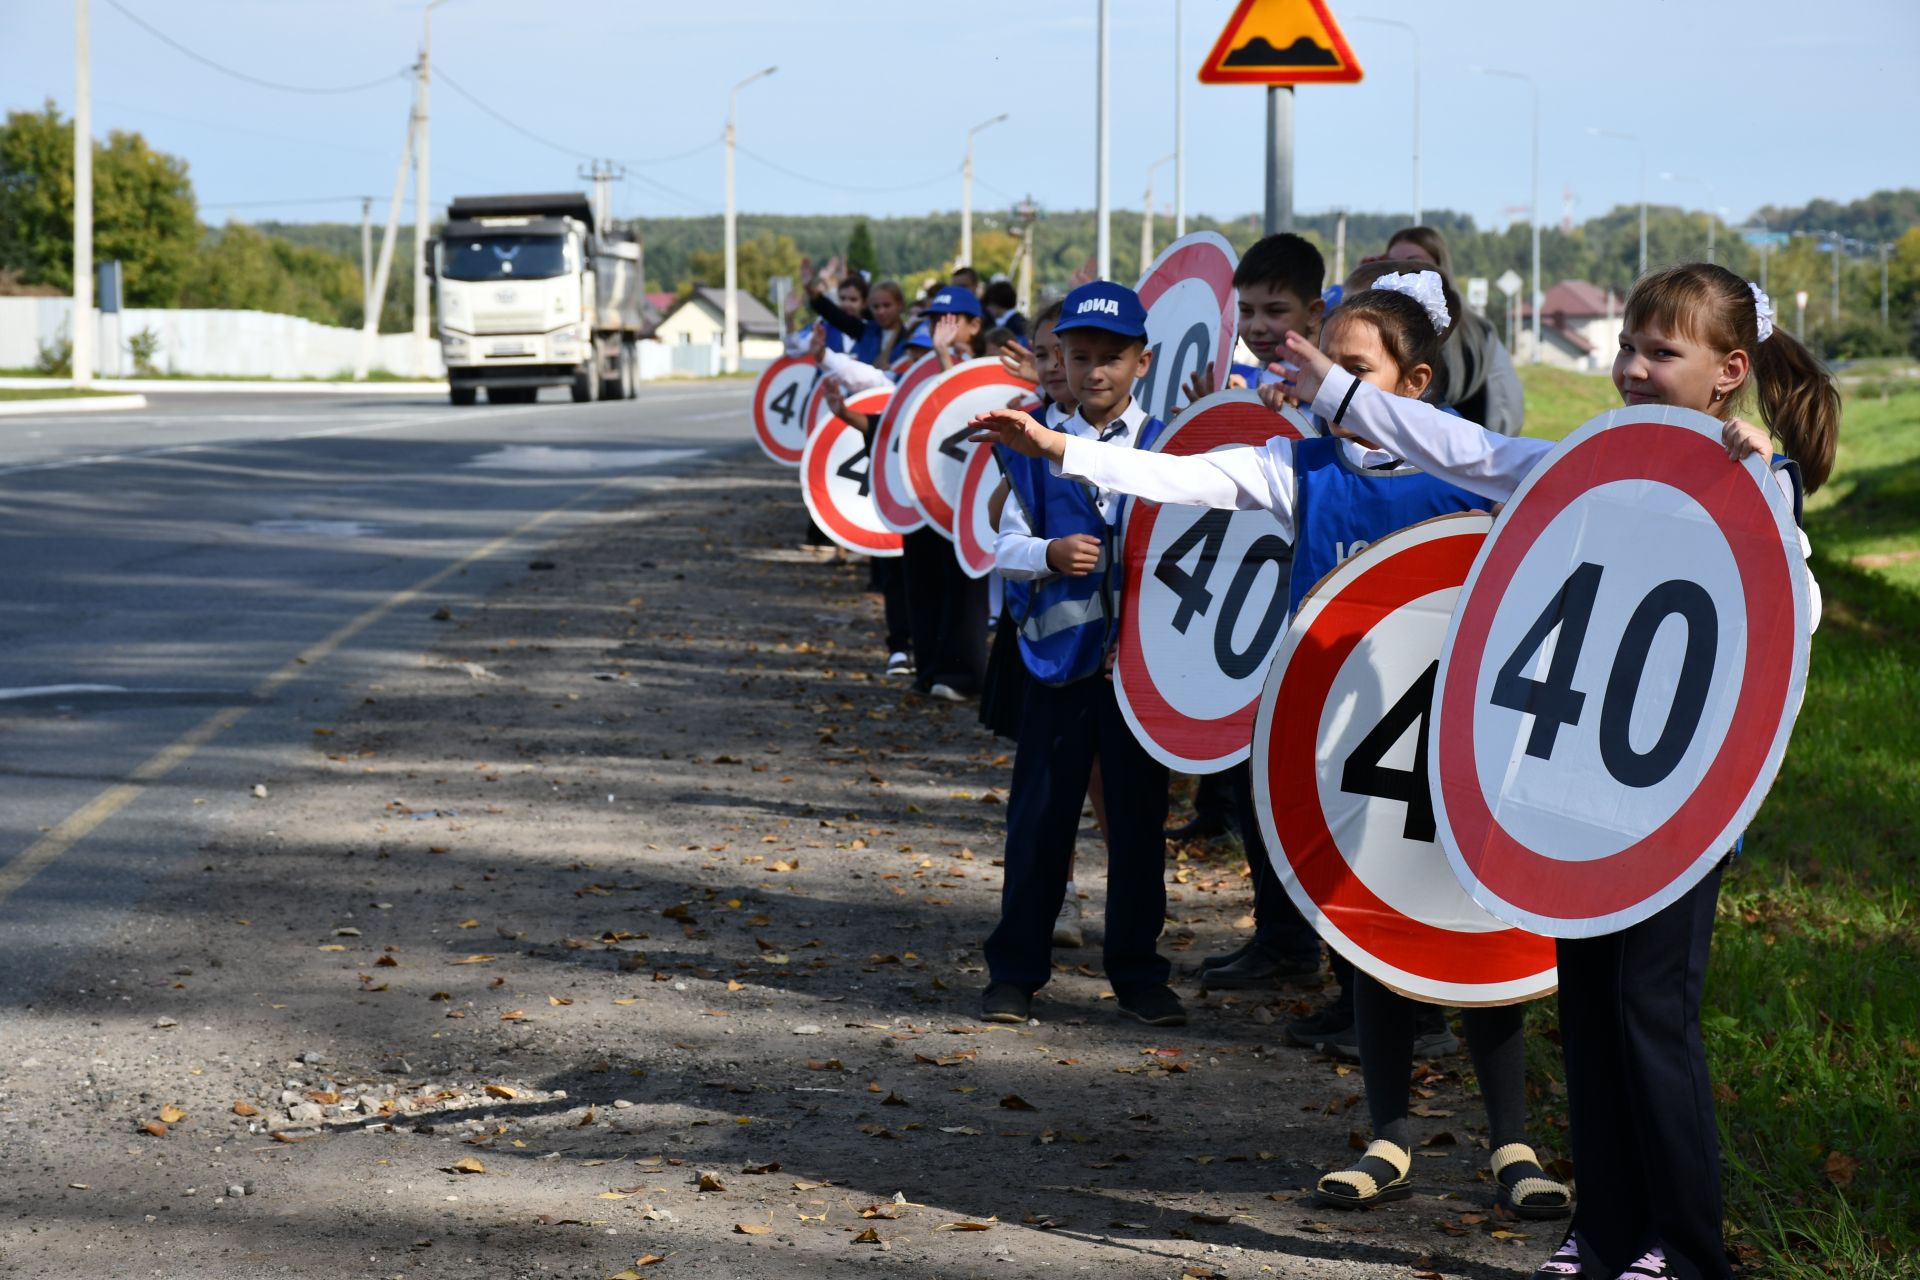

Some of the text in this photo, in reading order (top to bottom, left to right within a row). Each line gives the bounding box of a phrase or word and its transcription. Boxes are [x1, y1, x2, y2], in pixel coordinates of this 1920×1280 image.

[1077, 298, 1119, 316] ЮИД
[1154, 507, 1294, 680] 40
[1490, 561, 1719, 788] 40
